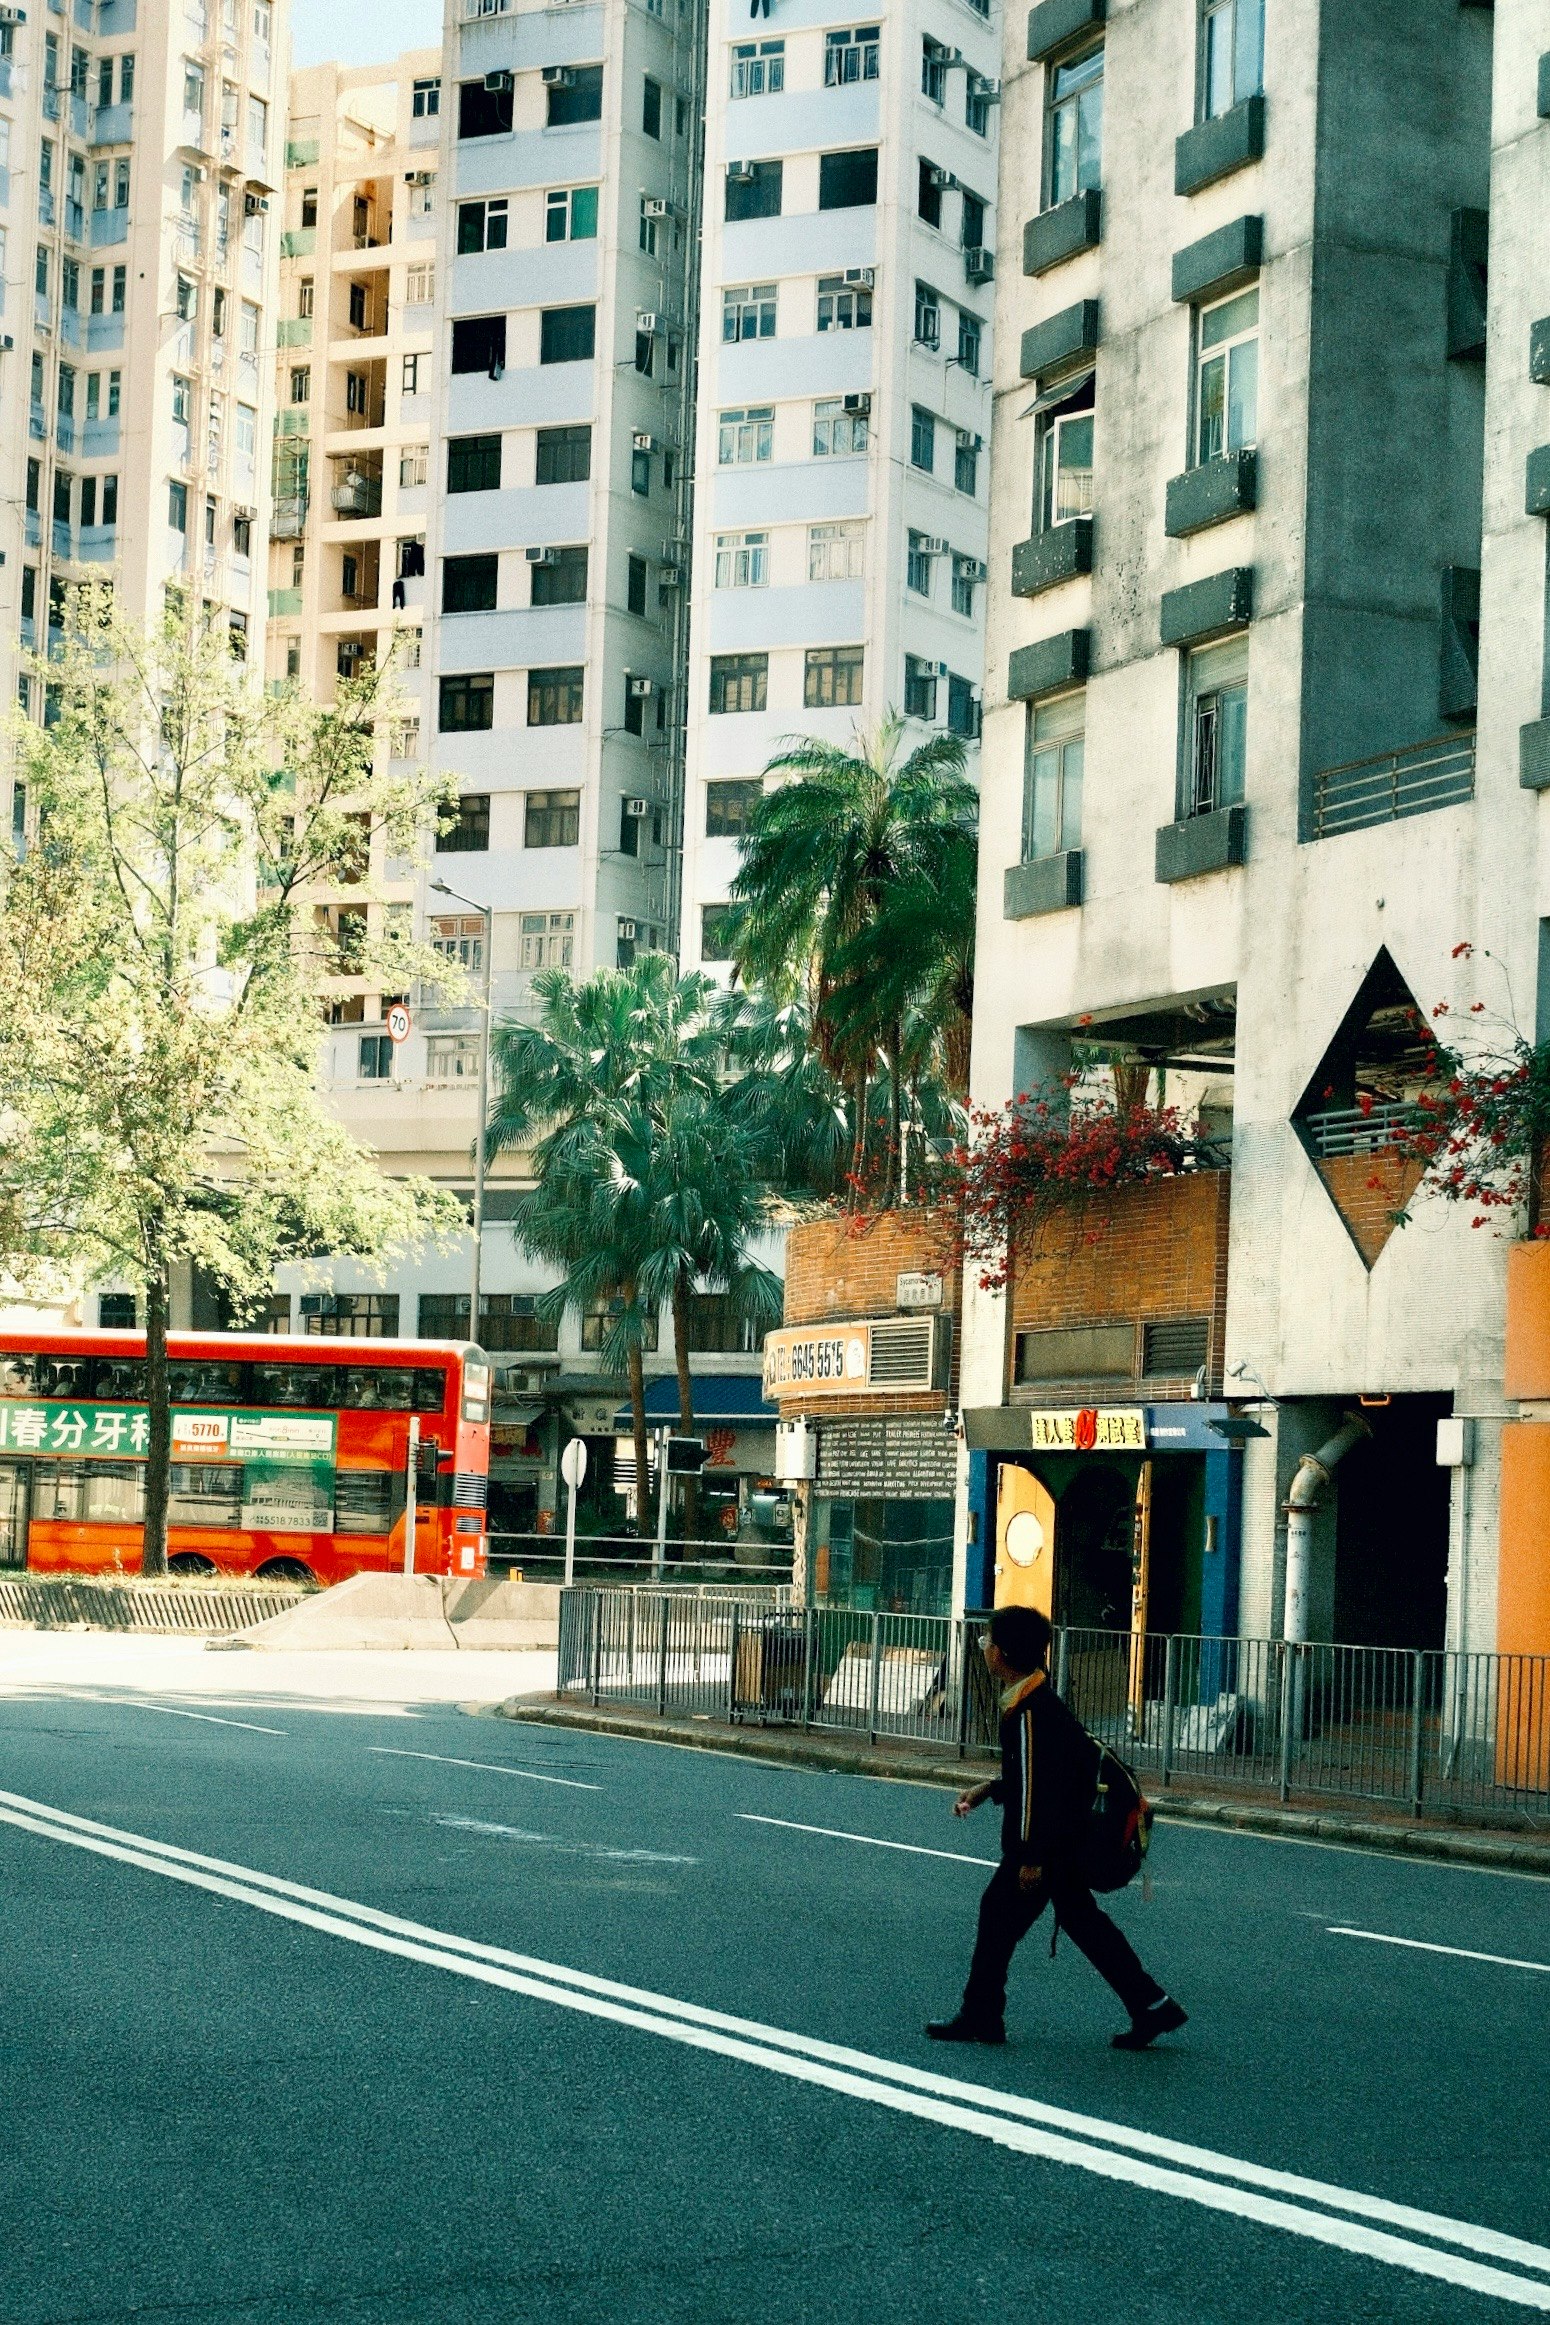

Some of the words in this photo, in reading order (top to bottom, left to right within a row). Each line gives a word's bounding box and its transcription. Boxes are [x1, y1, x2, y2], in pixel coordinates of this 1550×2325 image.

[392, 1014, 406, 1032] 70
[791, 1343, 815, 1380] 6645
[817, 1340, 844, 1378] 5515
[0, 1403, 150, 1451] 春分牙科
[192, 1423, 219, 1437] 5770
[264, 1515, 286, 1525] 5518
[288, 1517, 310, 1526] 7833
